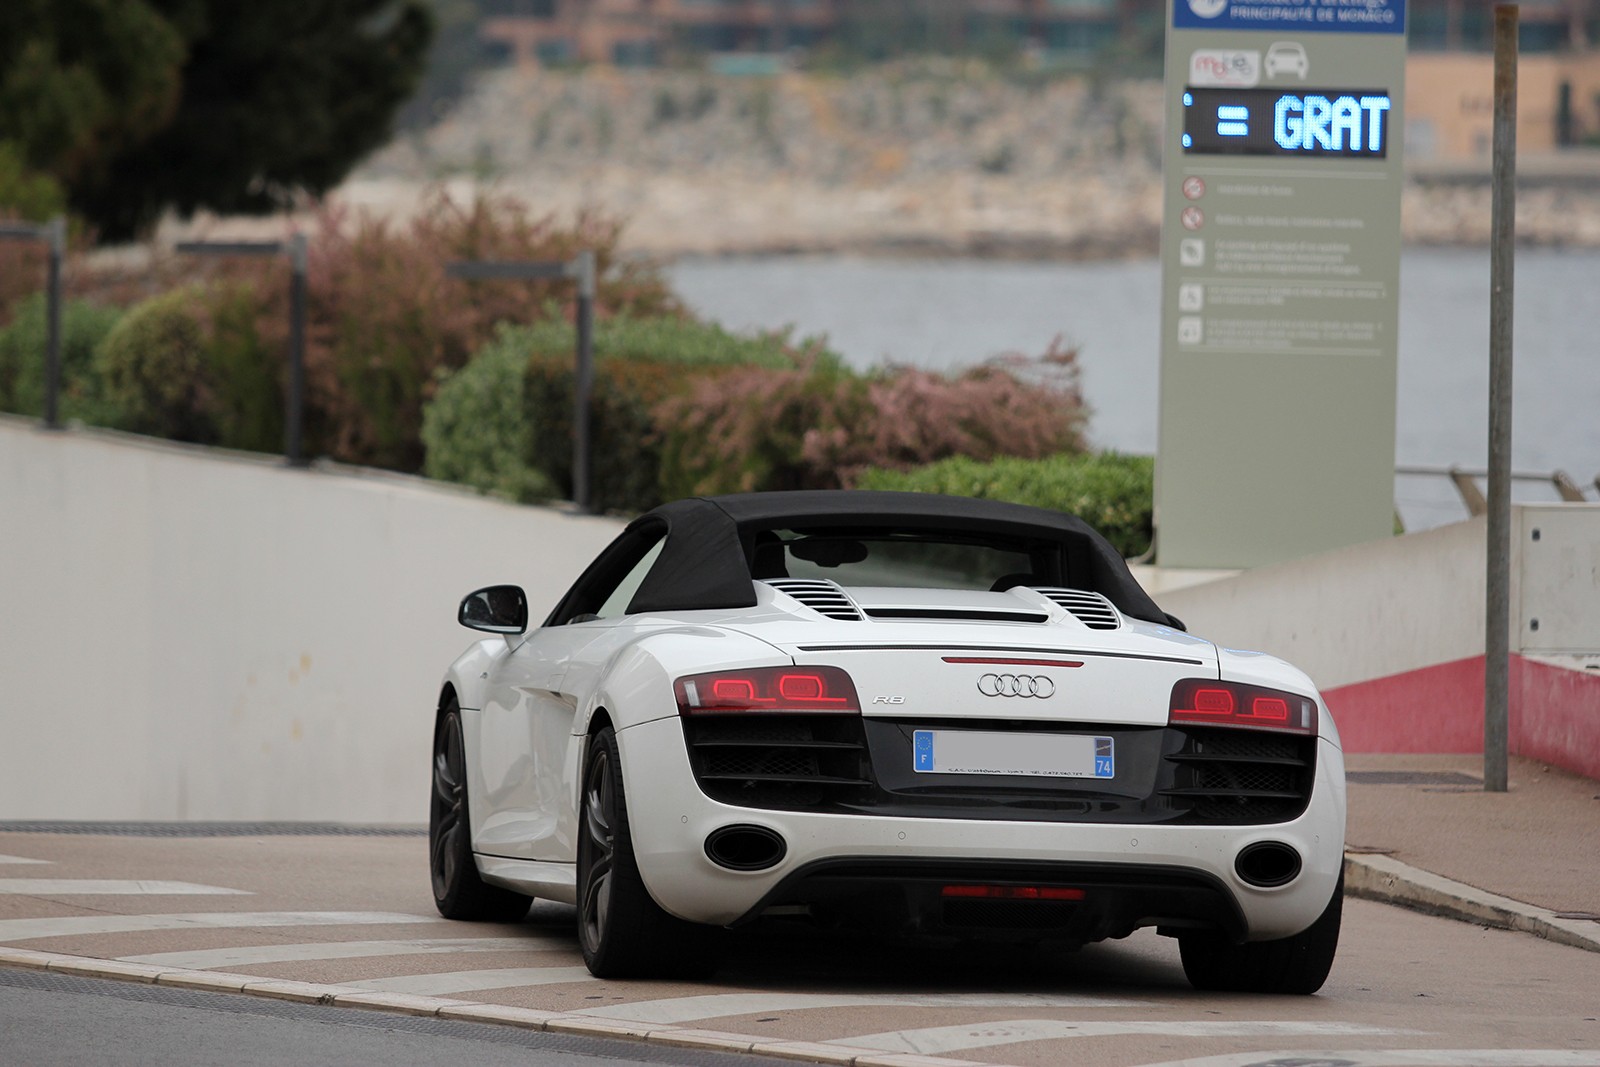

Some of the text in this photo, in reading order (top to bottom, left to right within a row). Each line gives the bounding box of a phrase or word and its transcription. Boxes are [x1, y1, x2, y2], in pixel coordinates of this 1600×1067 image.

[1316, 7, 1334, 22] DE
[1337, 7, 1396, 24] MONACO
[1274, 95, 1390, 151] GRAT
[873, 696, 906, 705] R8
[921, 754, 928, 764] F
[1096, 760, 1111, 774] 74
